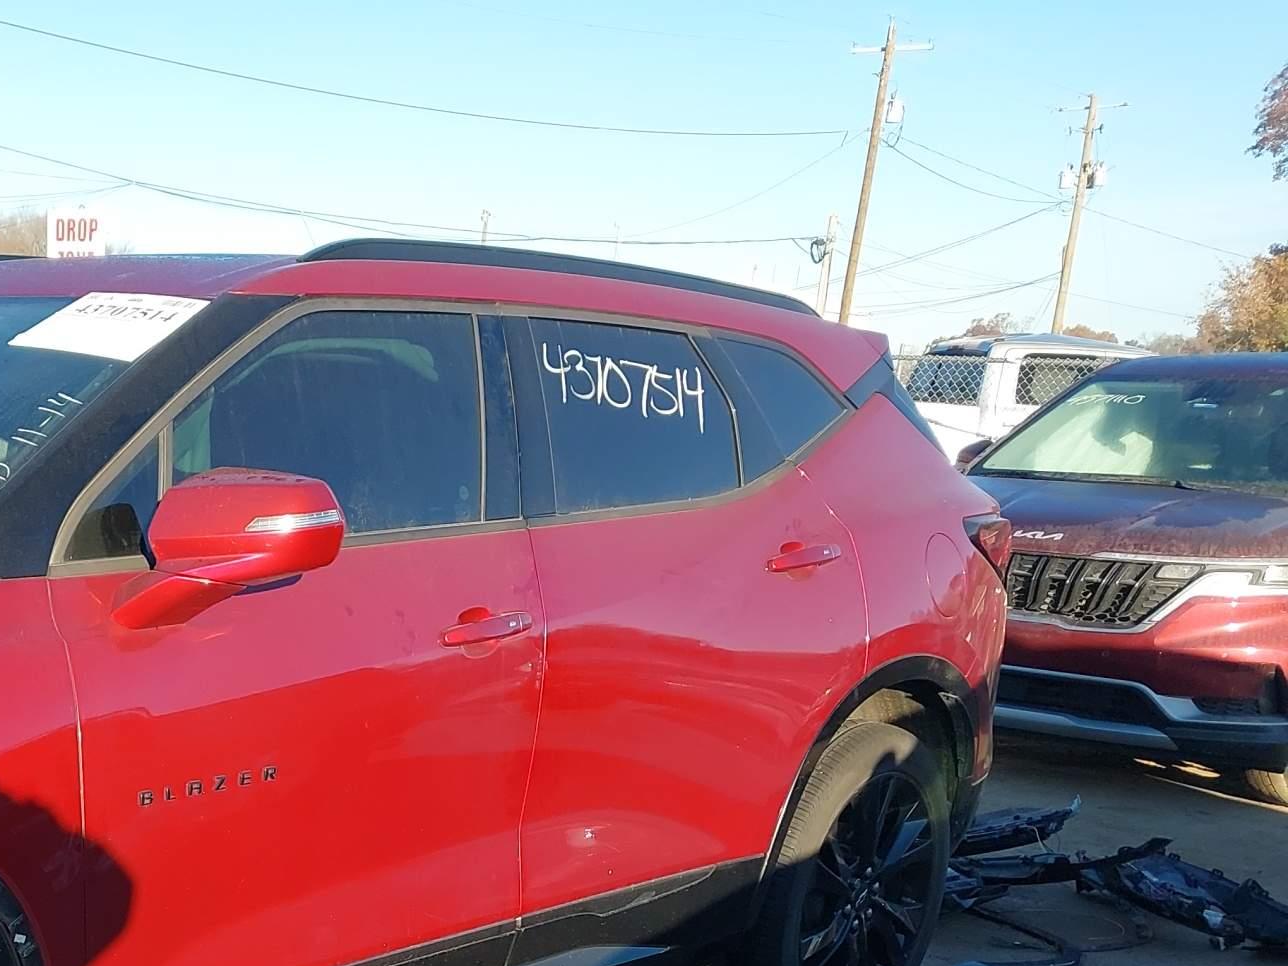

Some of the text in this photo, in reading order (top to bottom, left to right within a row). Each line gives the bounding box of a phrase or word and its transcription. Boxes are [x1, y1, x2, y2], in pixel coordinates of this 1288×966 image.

[56, 218, 98, 242] DROP
[74, 303, 180, 324] 43707514
[542, 342, 705, 435] 43707514
[10, 392, 84, 448] 11-14
[138, 765, 279, 808] BLAZER
